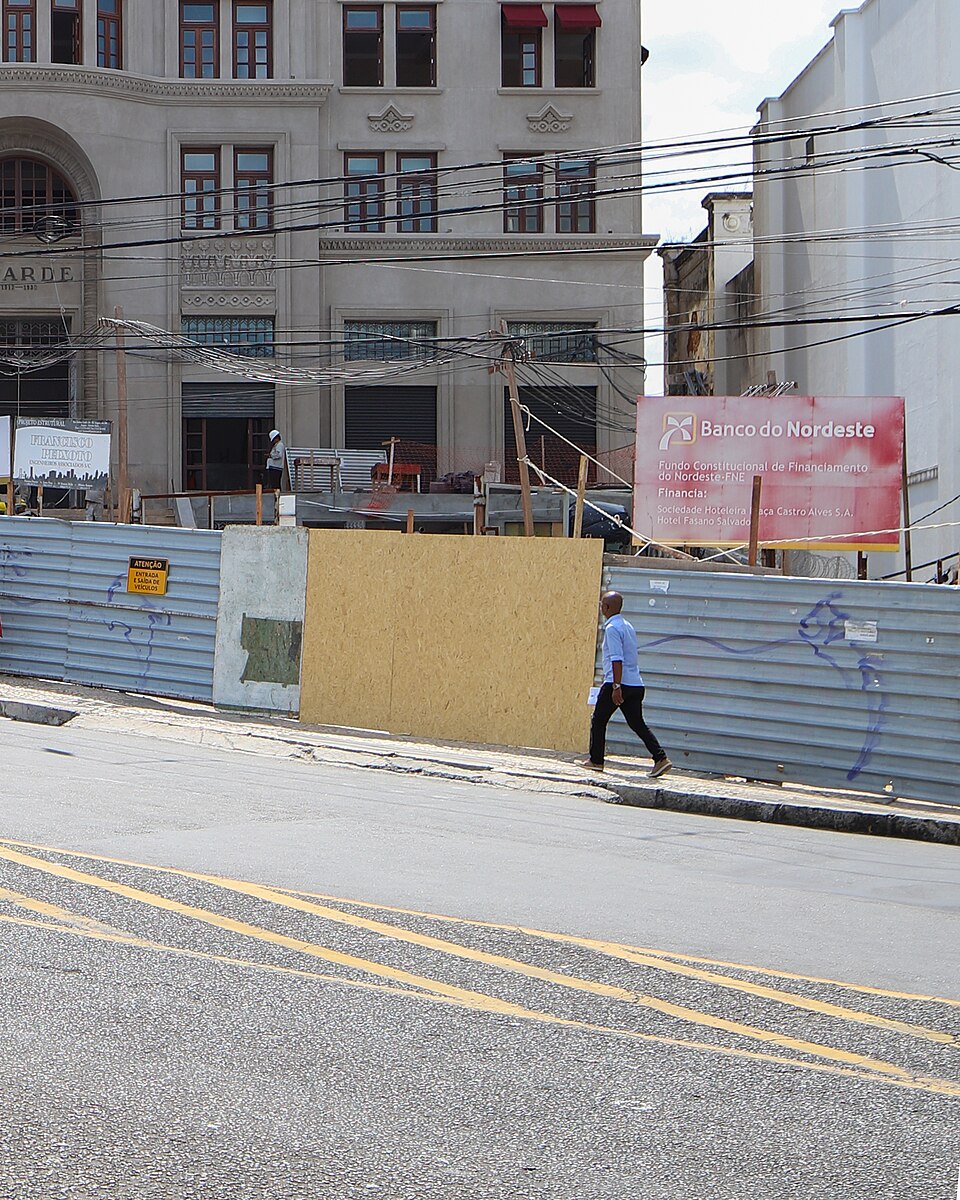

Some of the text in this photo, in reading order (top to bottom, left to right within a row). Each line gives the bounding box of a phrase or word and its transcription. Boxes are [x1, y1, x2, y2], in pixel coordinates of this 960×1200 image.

[17, 419, 37, 427] PROJETO
[37, 419, 66, 428] ESTRUTURAL
[700, 421, 876, 439] Banco do Nordeste
[30, 434, 94, 449] FRANCISCO
[41, 448, 93, 462] PEIXOTO
[658, 461, 868, 473] Fundo Constitucional de Financiamento
[658, 471, 745, 483] do Nordeste-FNE
[658, 488, 708, 499] Financia:
[657, 505, 702, 515] Sociedade
[704, 506, 747, 516] Hoteleira
[776, 507, 807, 517] Castro
[808, 507, 833, 518] Alves
[835, 507, 854, 518] S.A.
[657, 516, 752, 527] Hotel Fasano Salvado
[134, 560, 162, 569] ATENÇÃO
